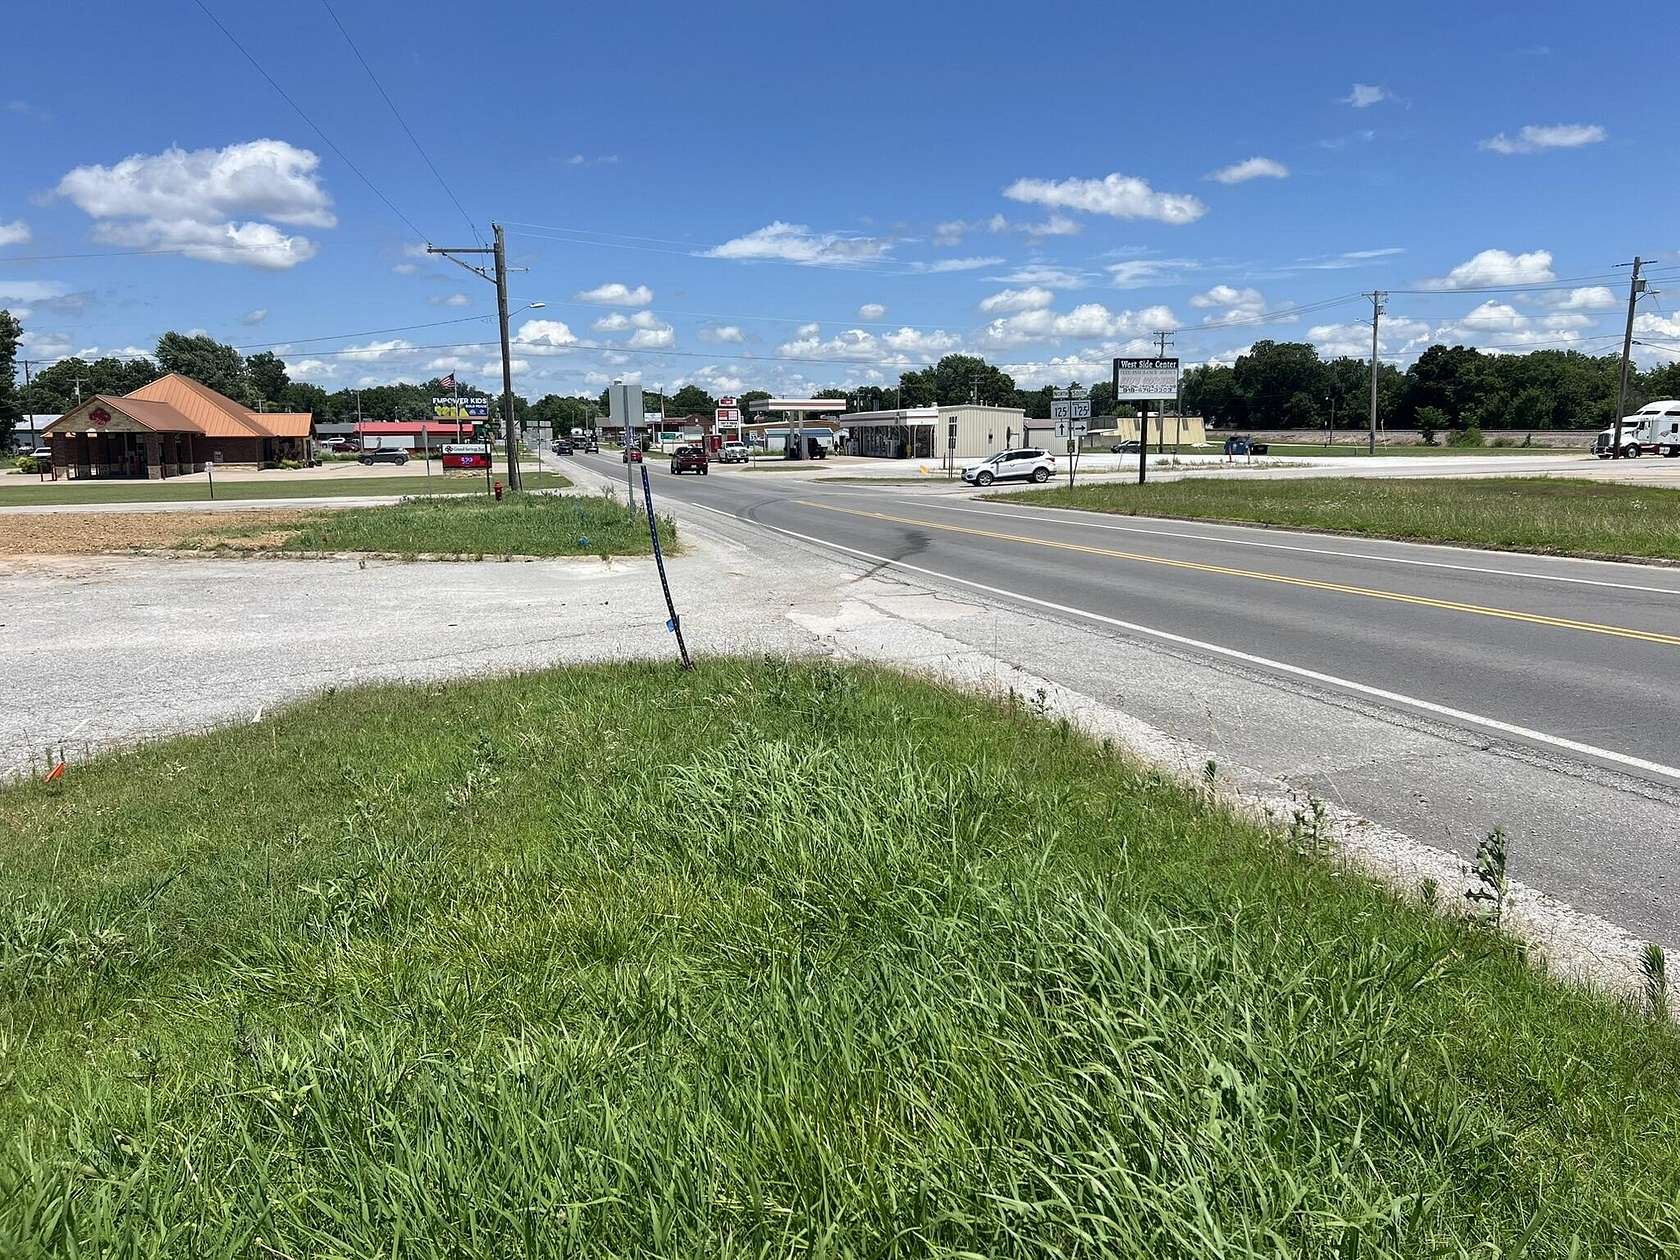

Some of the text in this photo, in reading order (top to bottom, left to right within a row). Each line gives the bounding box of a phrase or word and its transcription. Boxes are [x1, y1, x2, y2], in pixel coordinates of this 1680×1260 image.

[1121, 360, 1177, 368] West Side Center
[1055, 406, 1067, 417] 125
[1074, 405, 1088, 416] 125
